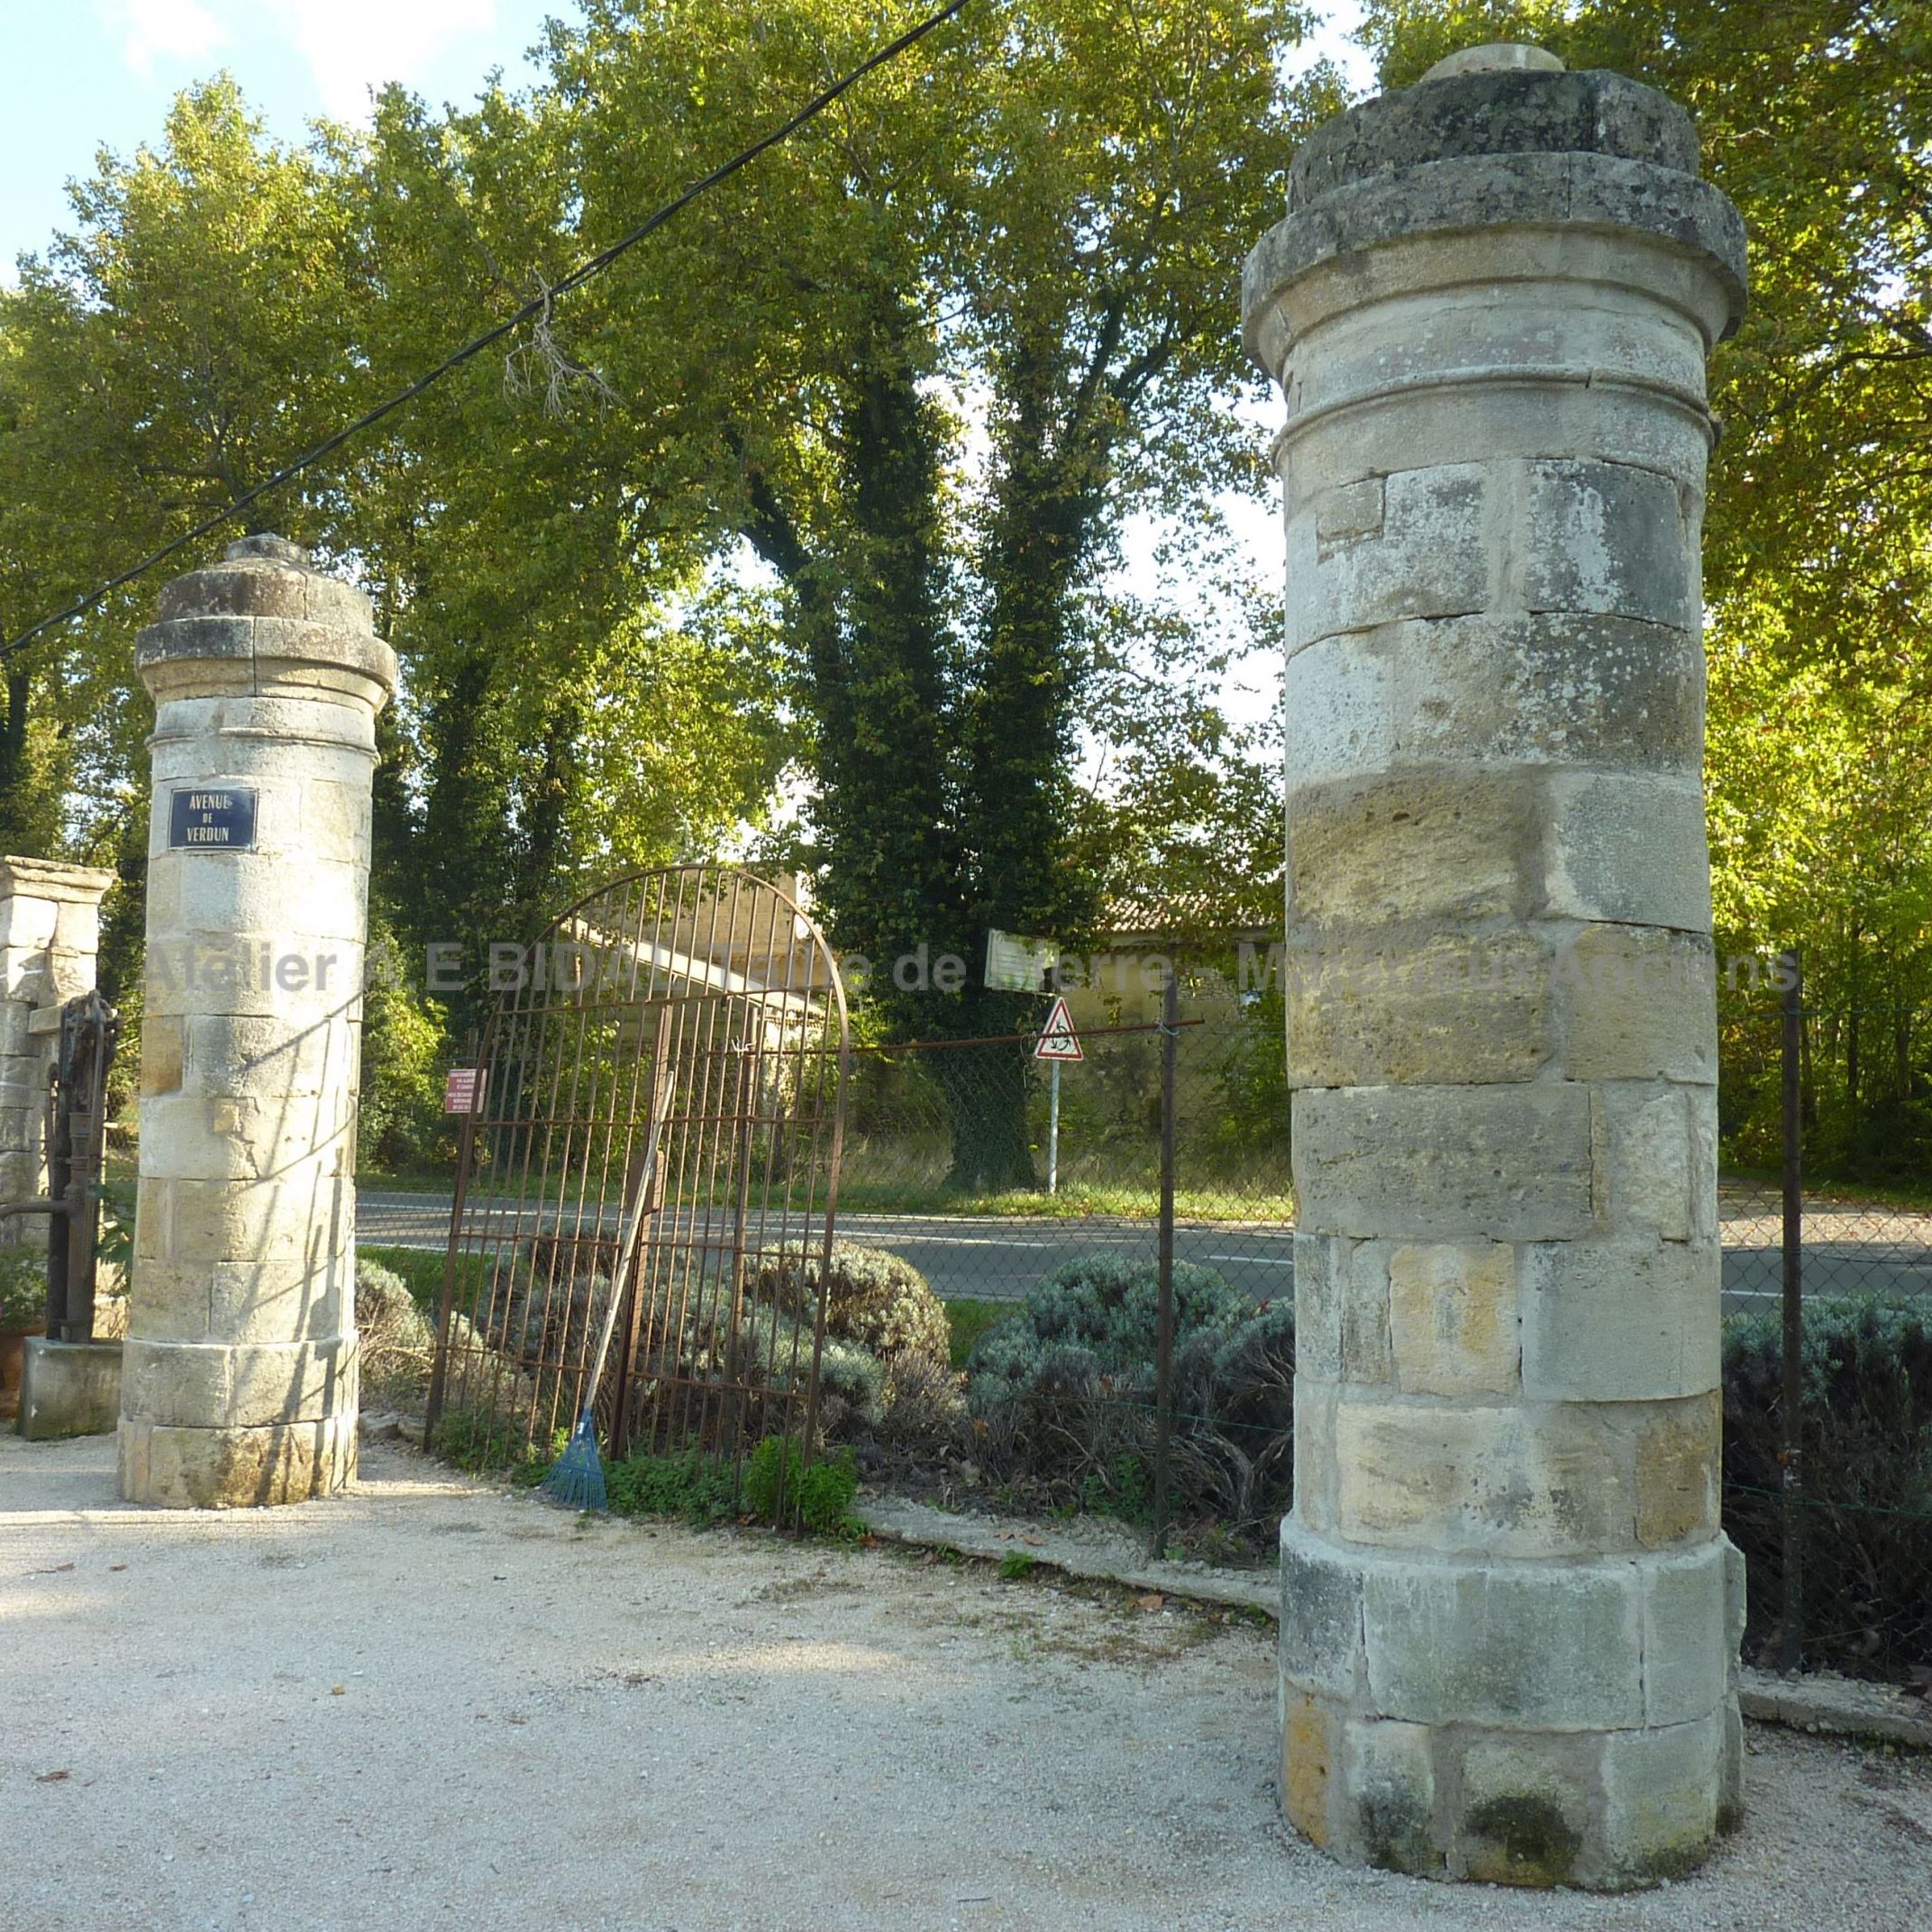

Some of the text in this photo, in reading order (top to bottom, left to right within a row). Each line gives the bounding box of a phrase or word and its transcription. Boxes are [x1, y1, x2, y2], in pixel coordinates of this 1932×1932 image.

[189, 793, 229, 809] AVENUE
[202, 813, 213, 824] DE
[187, 827, 229, 842] VERDUN
